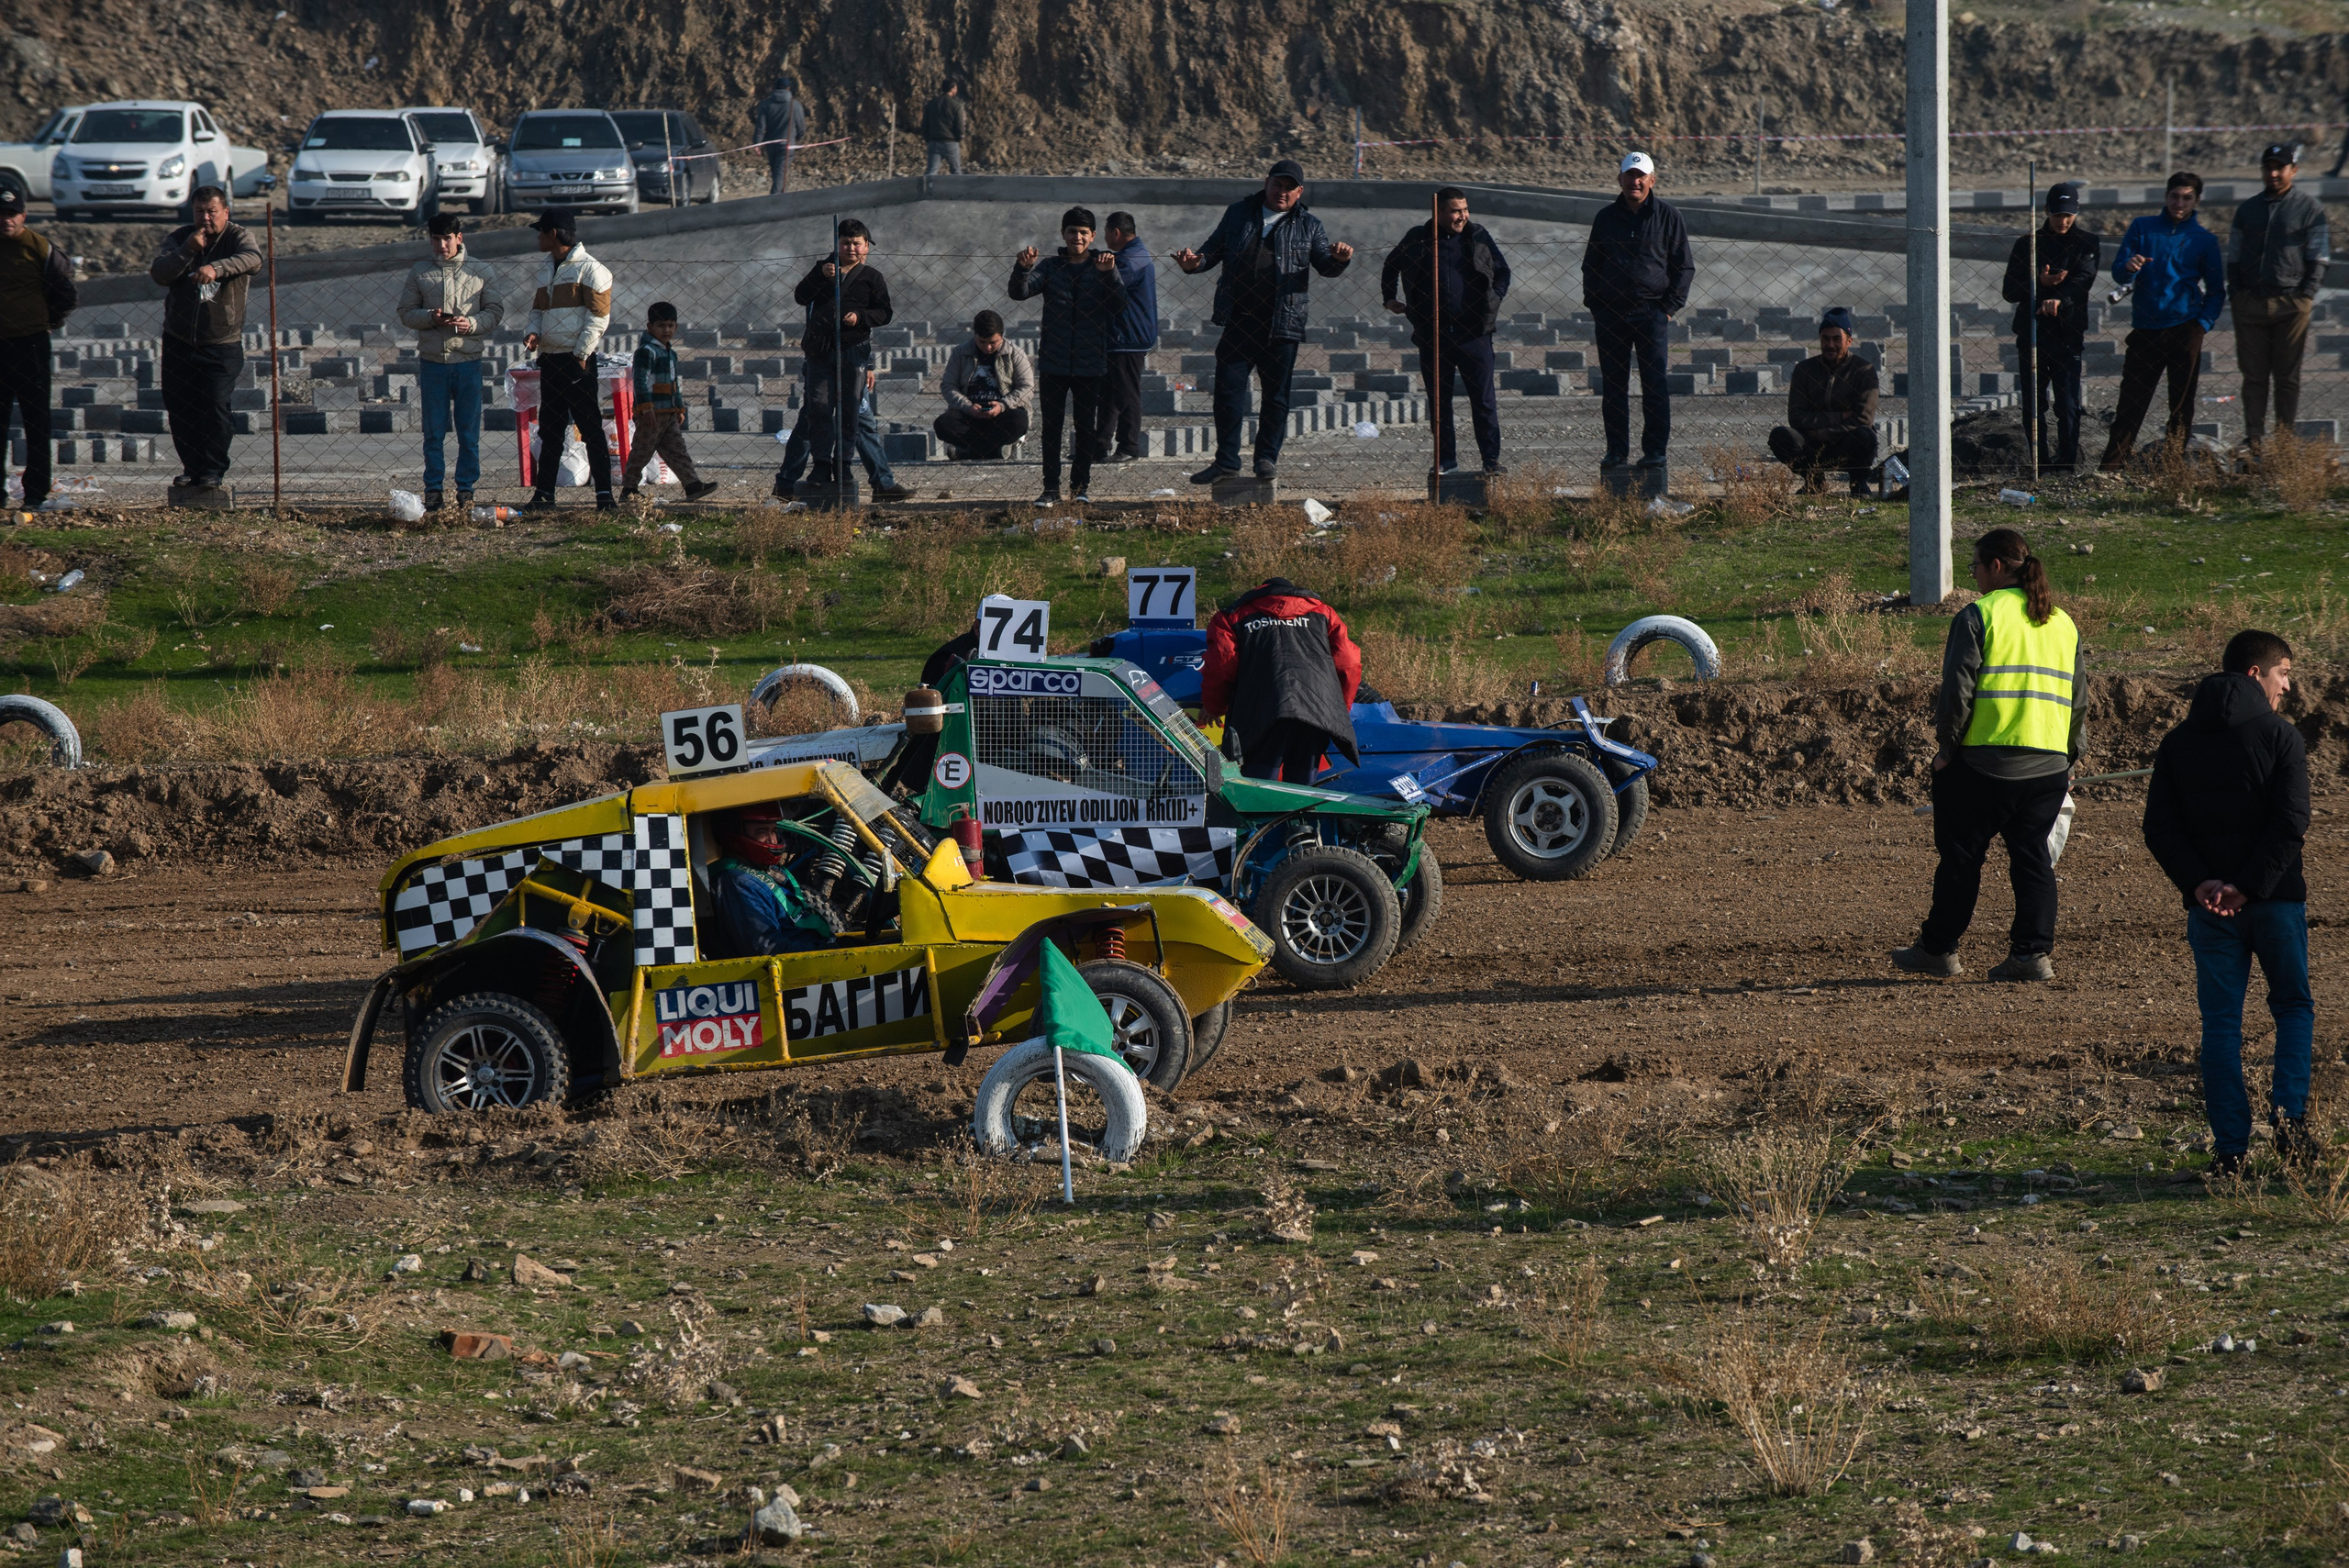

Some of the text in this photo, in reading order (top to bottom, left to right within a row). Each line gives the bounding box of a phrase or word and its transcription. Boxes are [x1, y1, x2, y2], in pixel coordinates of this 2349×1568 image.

[1132, 574, 1191, 616] 77
[984, 606, 1044, 653] 74
[969, 668, 1080, 695] sparco
[673, 711, 739, 768] 56
[944, 760, 961, 781] E
[1080, 798, 1139, 822] ODILJON
[658, 983, 756, 1021] LIQUI
[783, 965, 932, 1040] БАГГИ
[661, 1016, 760, 1055] MOLY
